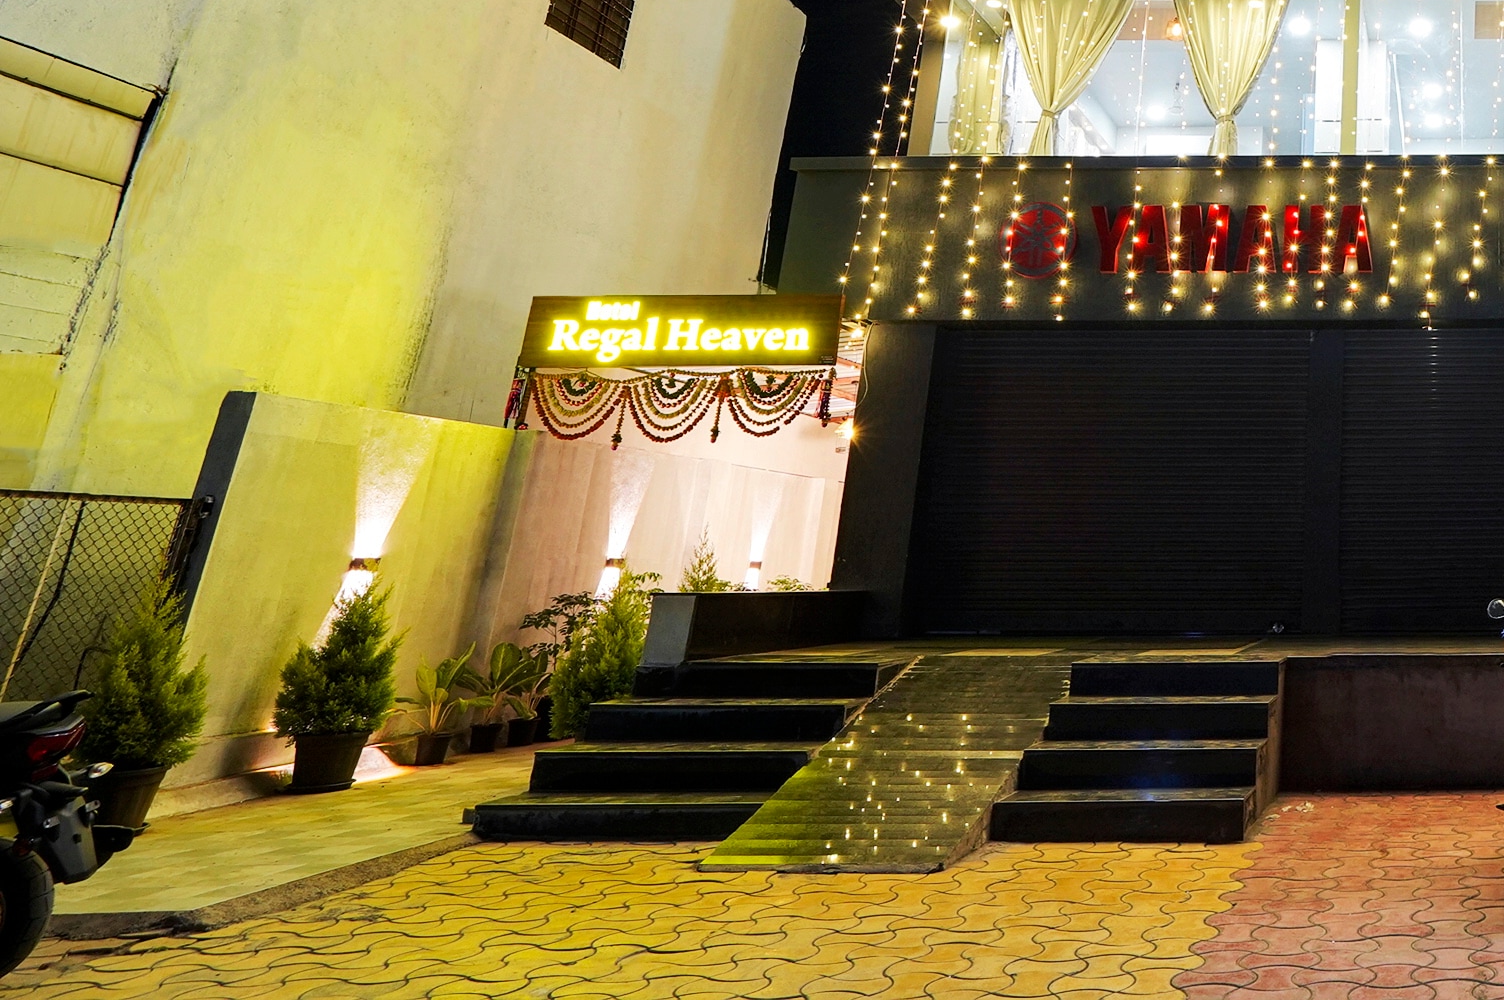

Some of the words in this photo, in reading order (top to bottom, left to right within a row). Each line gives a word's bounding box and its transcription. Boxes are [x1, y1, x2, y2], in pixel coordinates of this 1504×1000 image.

[1091, 204, 1374, 274] YAMAHA
[547, 316, 659, 362] Regal
[662, 318, 810, 351] Heaven
